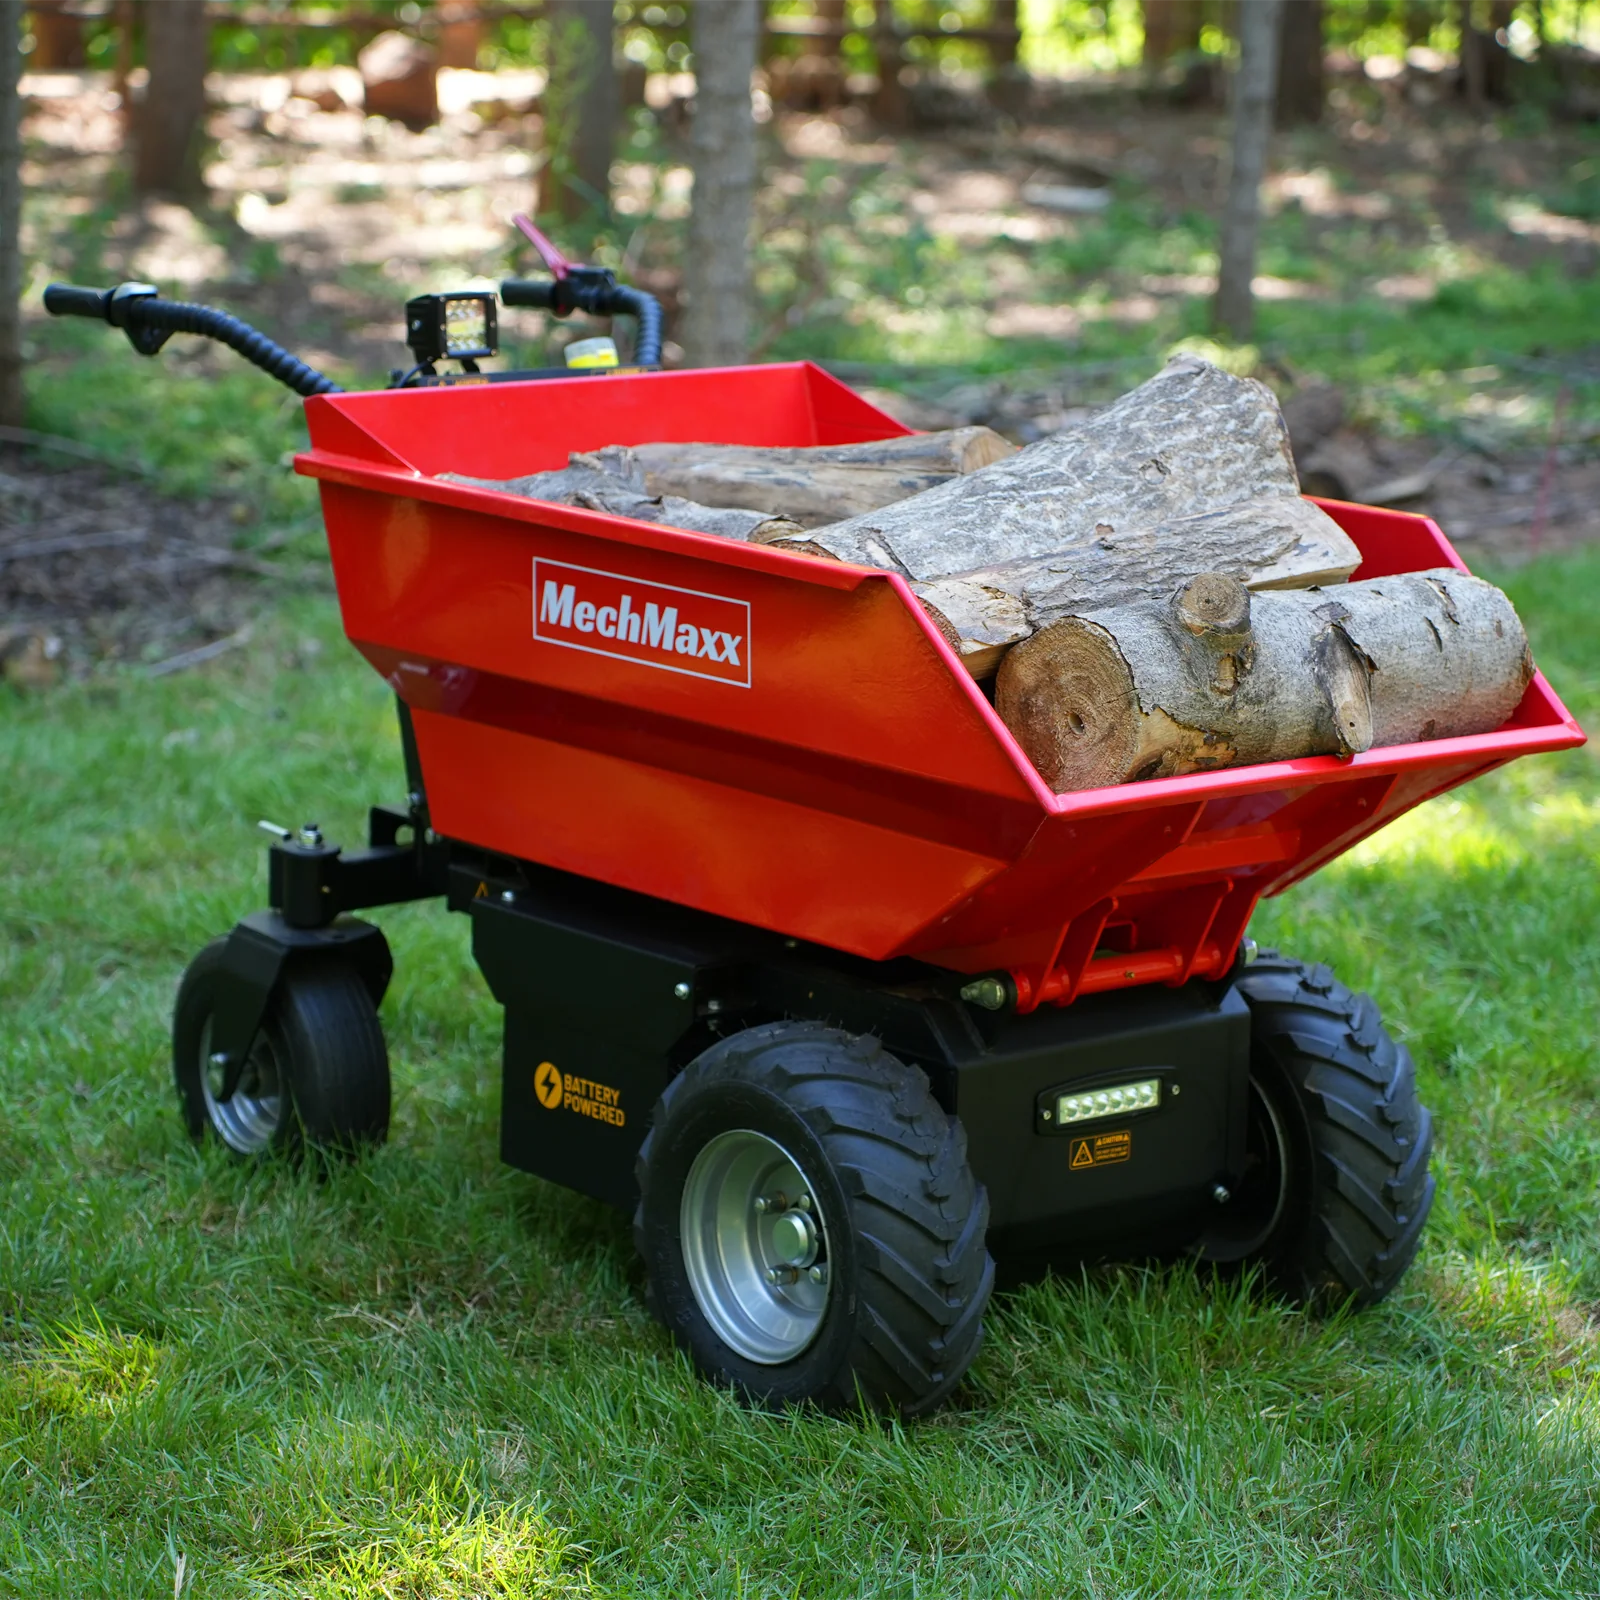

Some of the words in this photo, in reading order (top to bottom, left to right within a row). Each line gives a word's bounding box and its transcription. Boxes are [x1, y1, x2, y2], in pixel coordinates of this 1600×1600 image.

[540, 580, 742, 666] MechMaxx
[564, 1074, 620, 1106] BATTERY
[564, 1092, 625, 1127] POWERED
